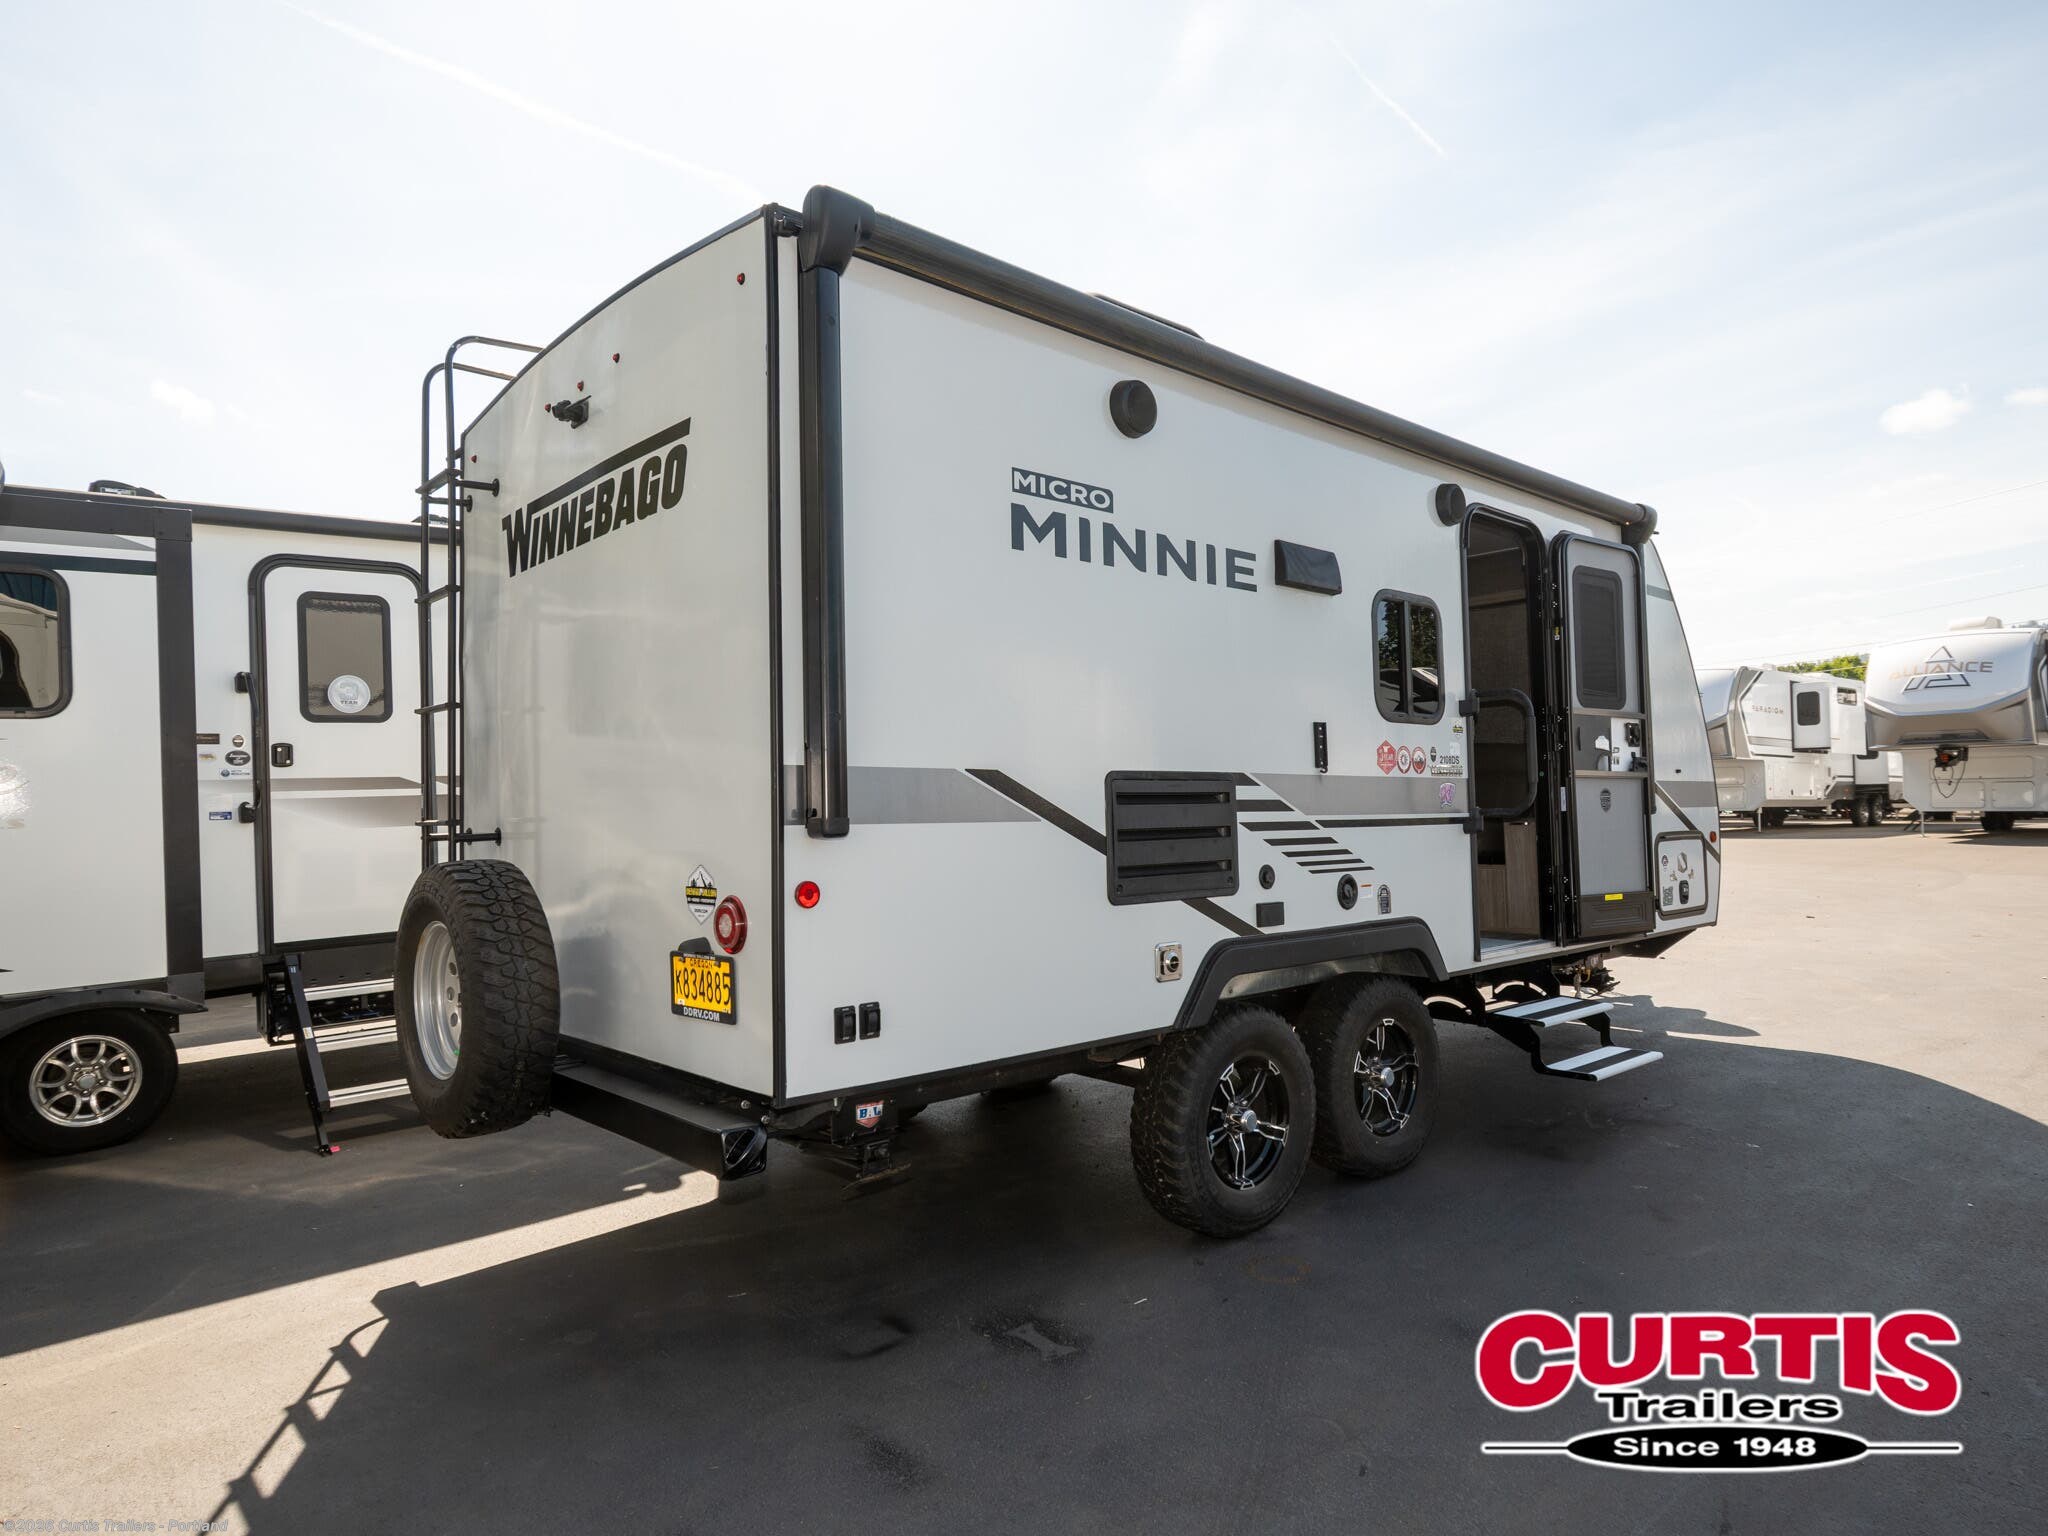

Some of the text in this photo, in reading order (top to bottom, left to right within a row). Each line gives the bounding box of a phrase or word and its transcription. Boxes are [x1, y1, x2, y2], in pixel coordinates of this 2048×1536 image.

[1013, 470, 1111, 509] MICRO
[502, 442, 688, 578] WINNEBAGO
[1011, 502, 1257, 592] MINNIE
[689, 957, 713, 969] OREGON
[675, 967, 731, 1006] K834885
[683, 1006, 720, 1022] DDRV.COM
